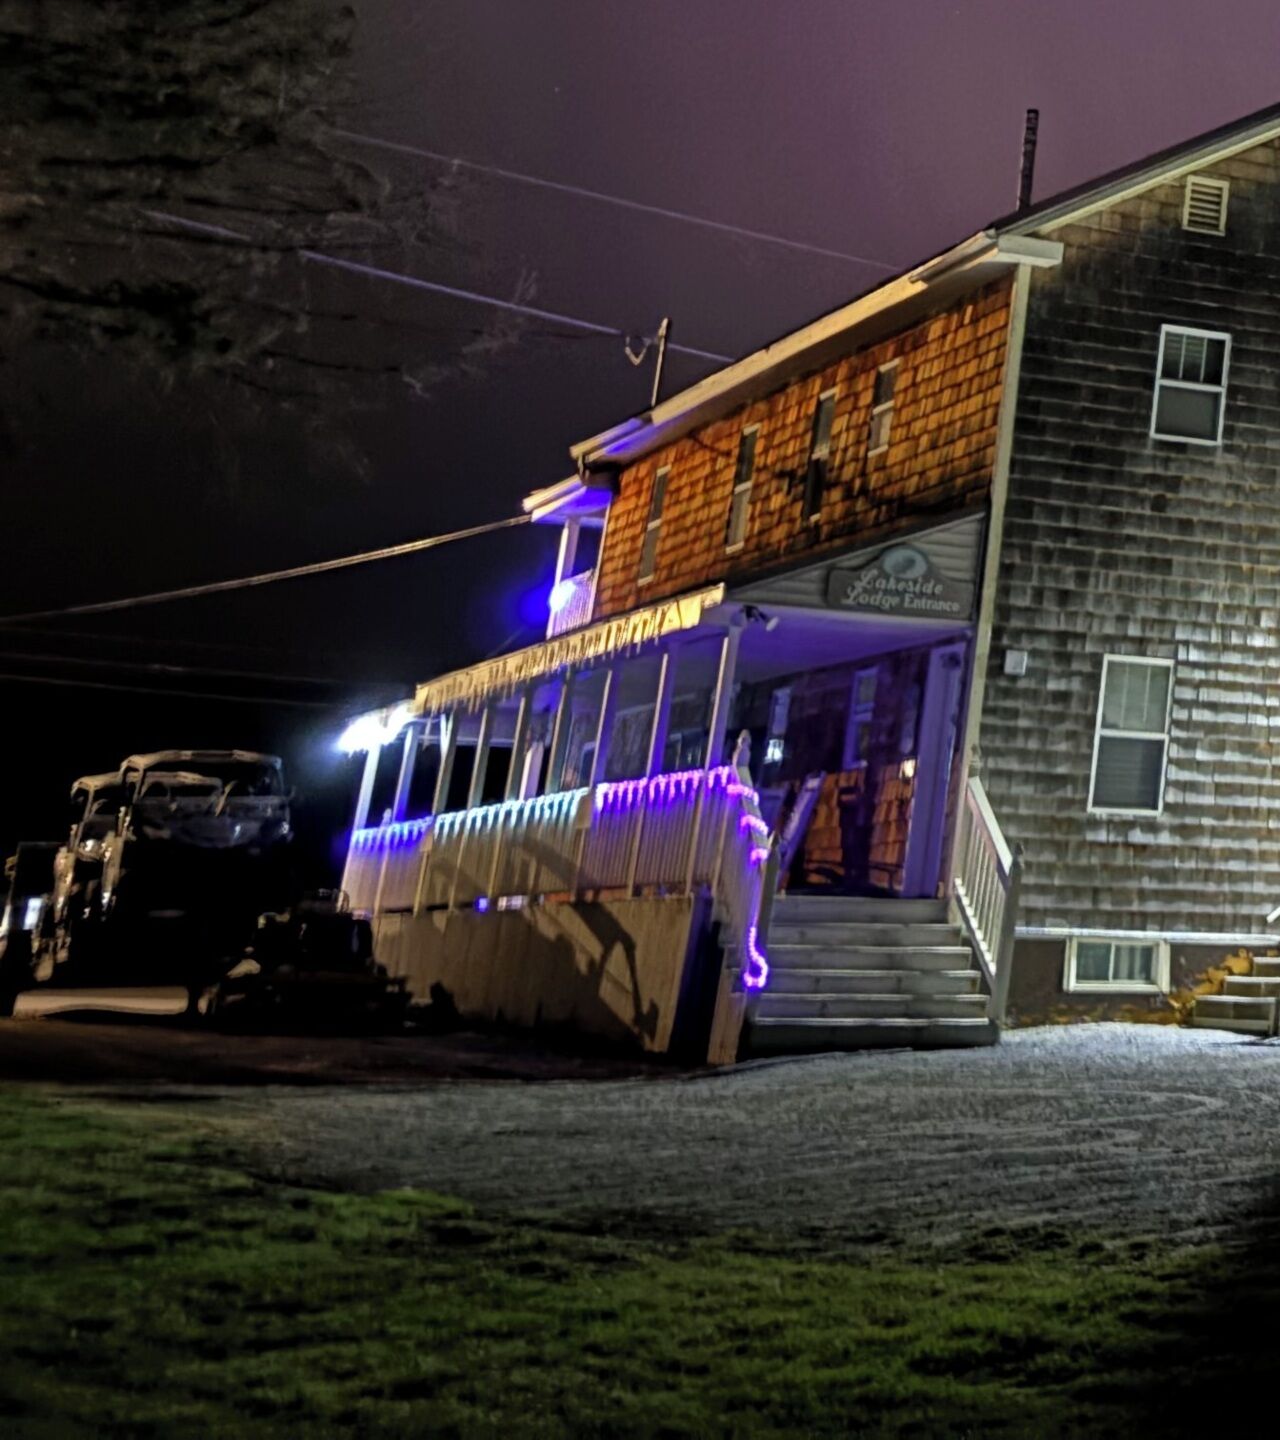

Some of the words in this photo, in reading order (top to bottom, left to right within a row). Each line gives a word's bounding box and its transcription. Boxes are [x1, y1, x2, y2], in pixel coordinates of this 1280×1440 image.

[854, 569, 943, 595] Lakeside
[841, 586, 900, 610] Lodge
[903, 593, 960, 612] Entrance
